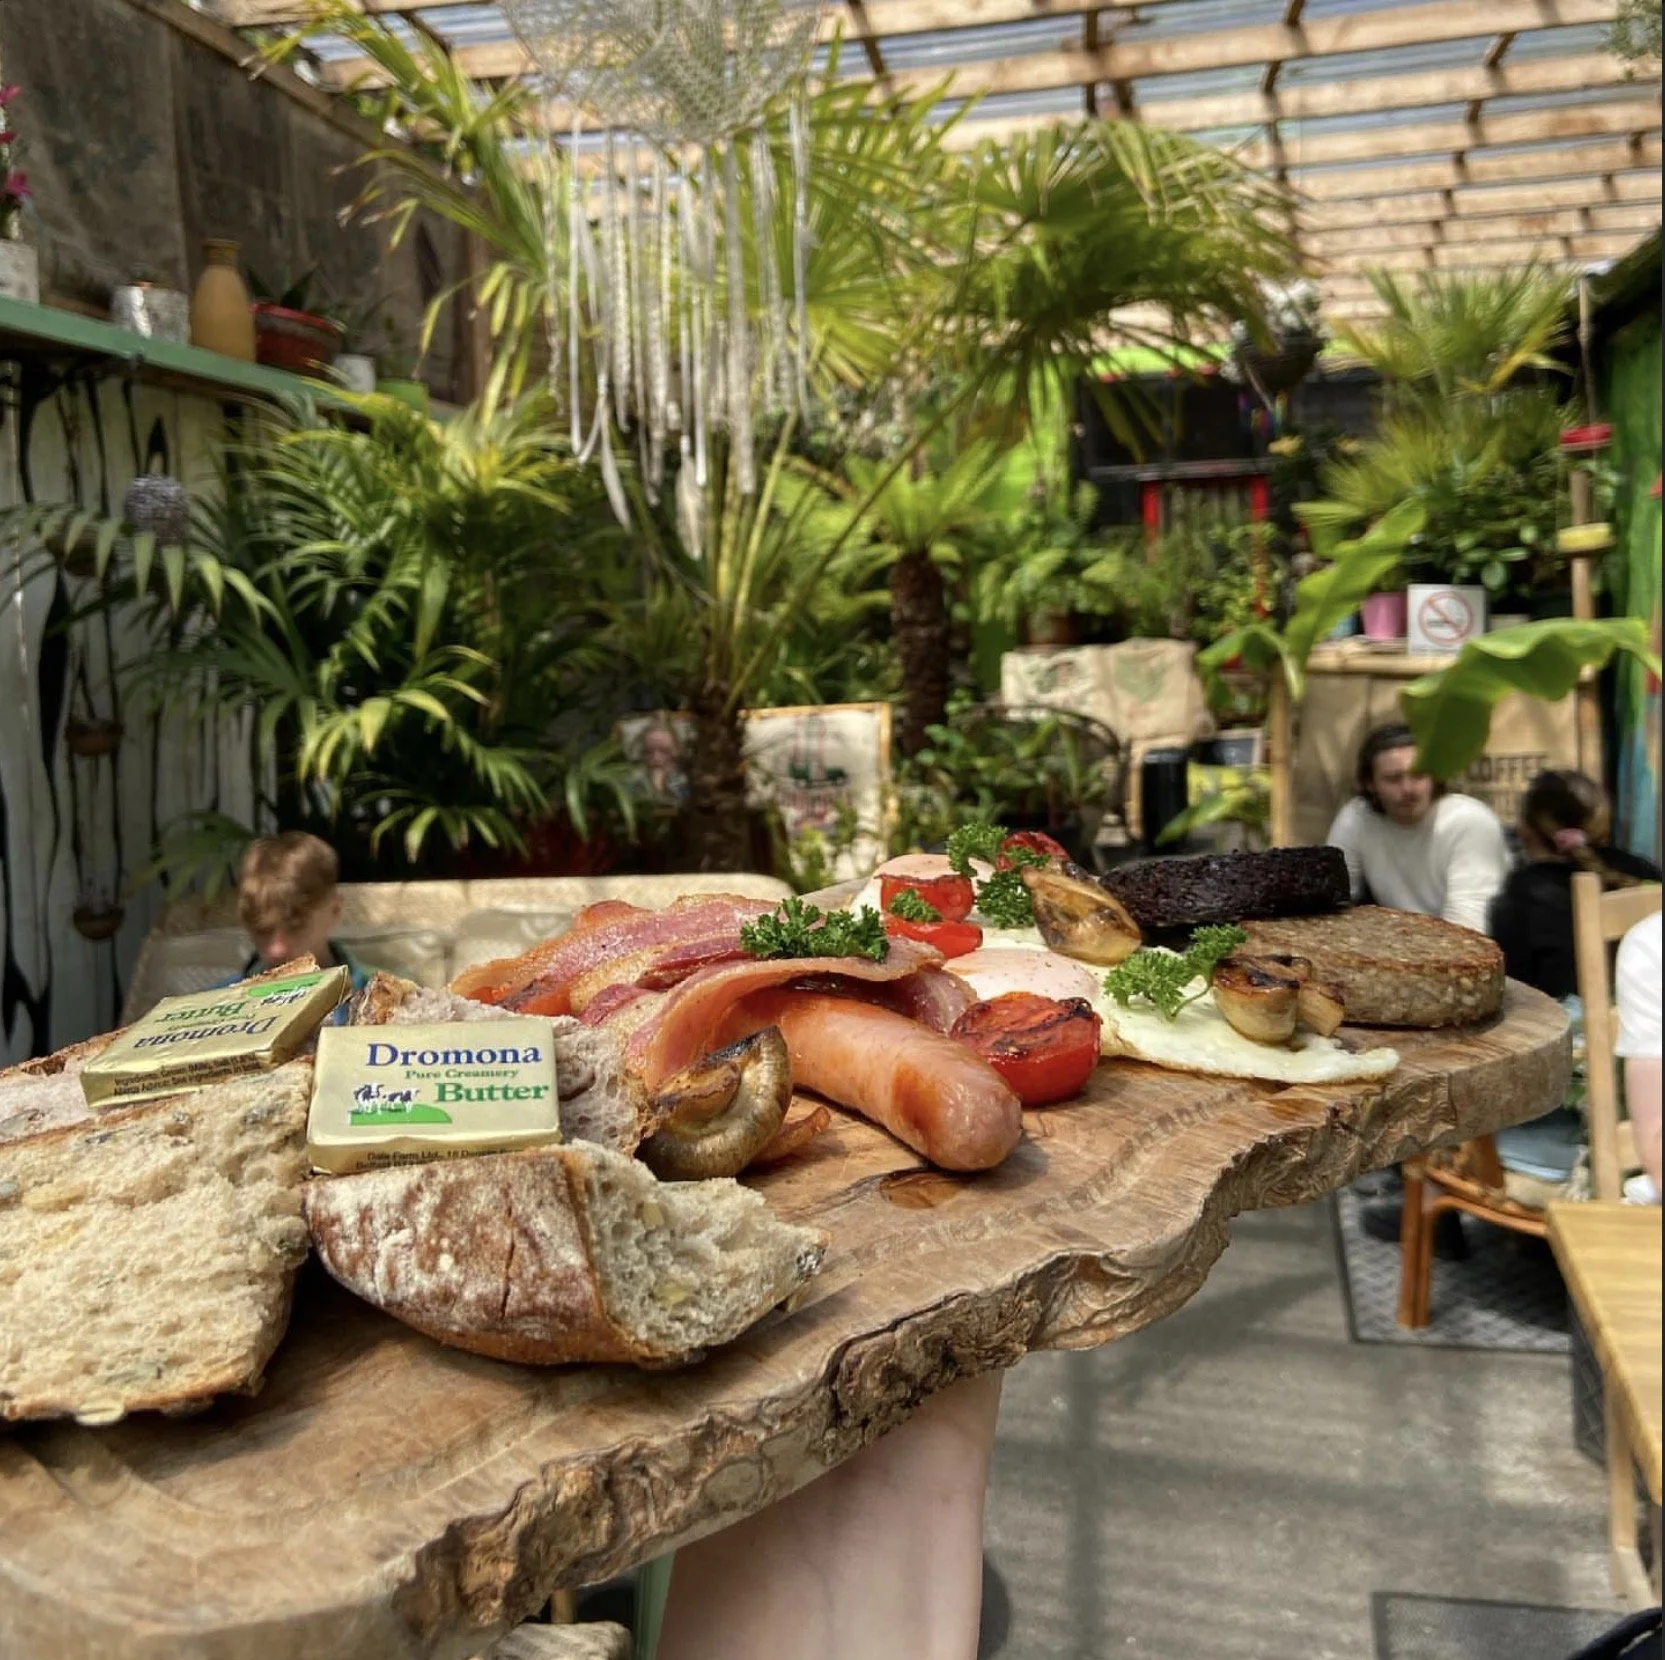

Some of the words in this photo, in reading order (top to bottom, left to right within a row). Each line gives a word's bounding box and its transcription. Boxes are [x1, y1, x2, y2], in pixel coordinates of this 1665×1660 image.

[155, 1001, 248, 1023] Butter
[133, 1016, 278, 1048] Dromona
[366, 1043, 543, 1067] Dromona
[404, 1069, 441, 1080] Pure
[445, 1068, 520, 1079] Creamery
[434, 1082, 550, 1103] Butter
